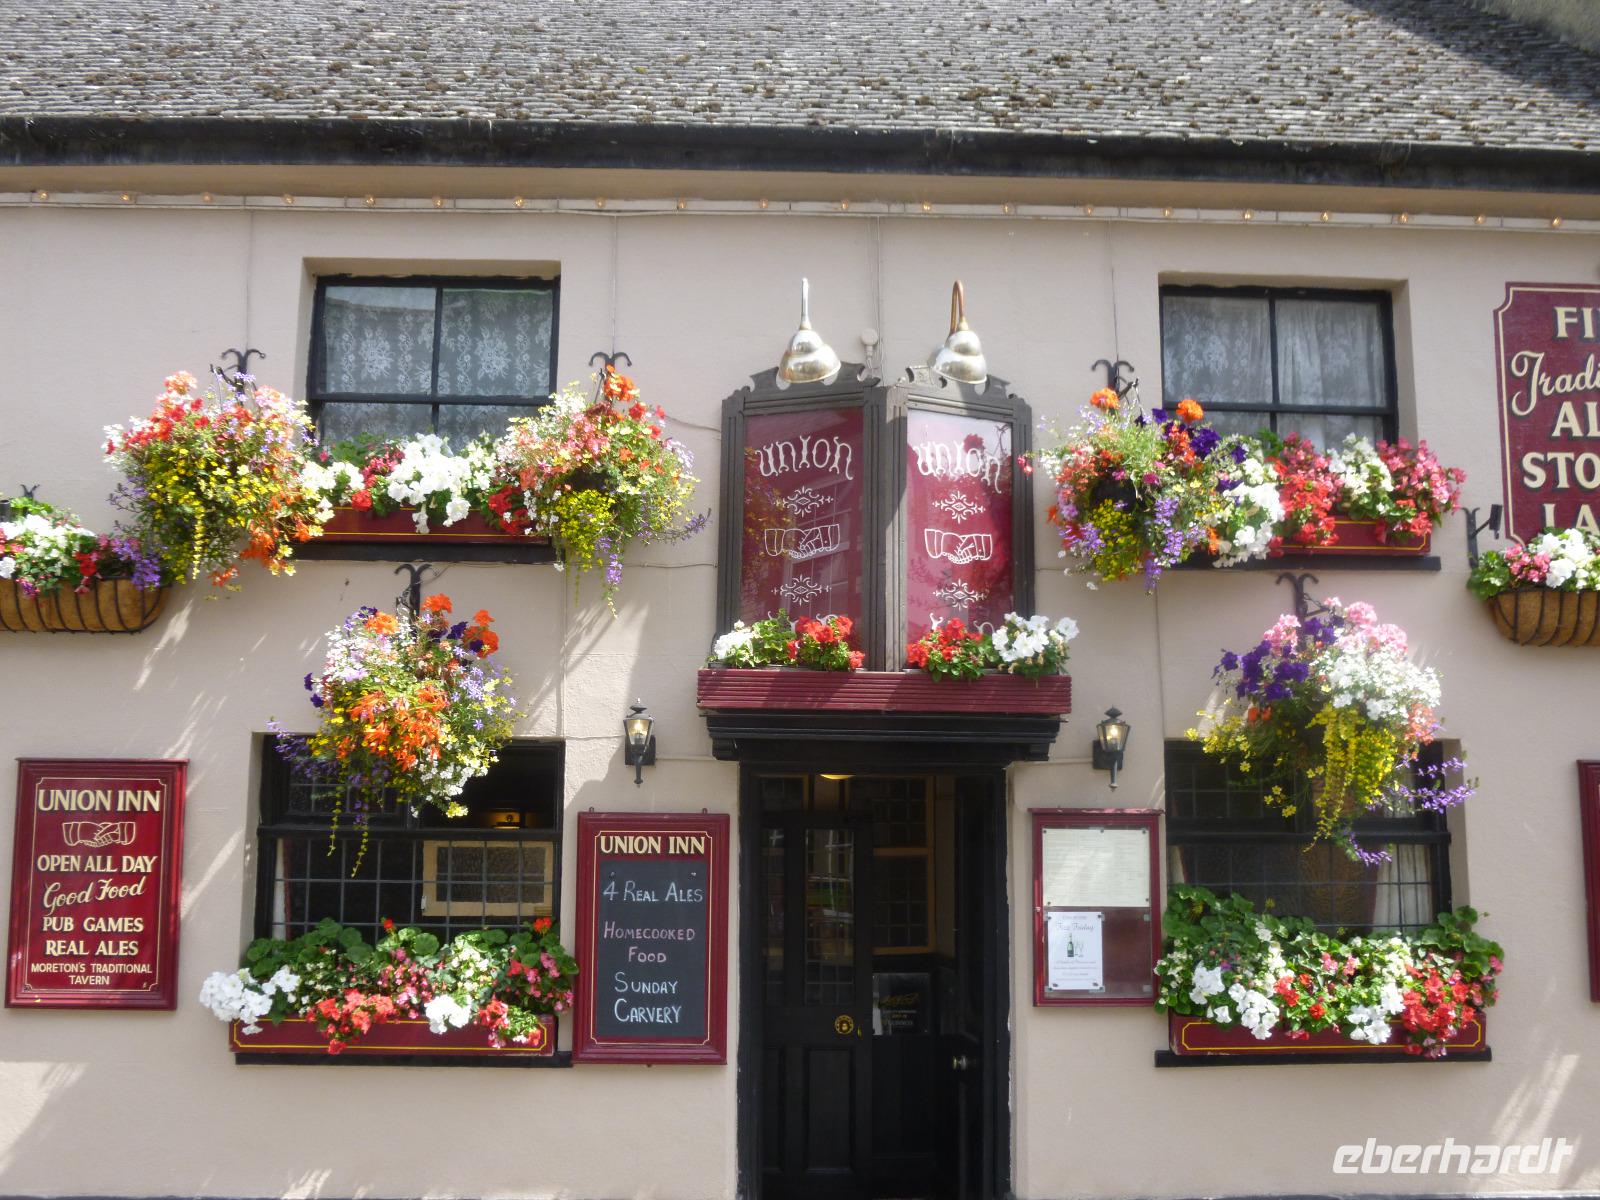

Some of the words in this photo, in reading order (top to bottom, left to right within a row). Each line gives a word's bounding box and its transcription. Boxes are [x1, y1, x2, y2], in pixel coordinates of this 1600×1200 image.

[1554, 306, 1600, 338] FI
[38, 789, 112, 812] UNION
[116, 790, 161, 812] INN
[600, 835, 661, 854] UNION
[668, 836, 705, 855] INN
[37, 855, 81, 872] OPEN
[84, 855, 117, 873] ALL
[121, 855, 157, 873] DAY
[43, 880, 94, 916] Good
[95, 876, 146, 902] Food
[603, 880, 619, 901] 4
[43, 917, 74, 932] PUB
[83, 917, 144, 933] GAMES
[45, 940, 89, 956] REAL
[95, 940, 139, 956] ALES
[31, 962, 86, 973] MORETON'S
[90, 963, 152, 974] TRADITIONAL
[68, 974, 110, 985] TAVERN
